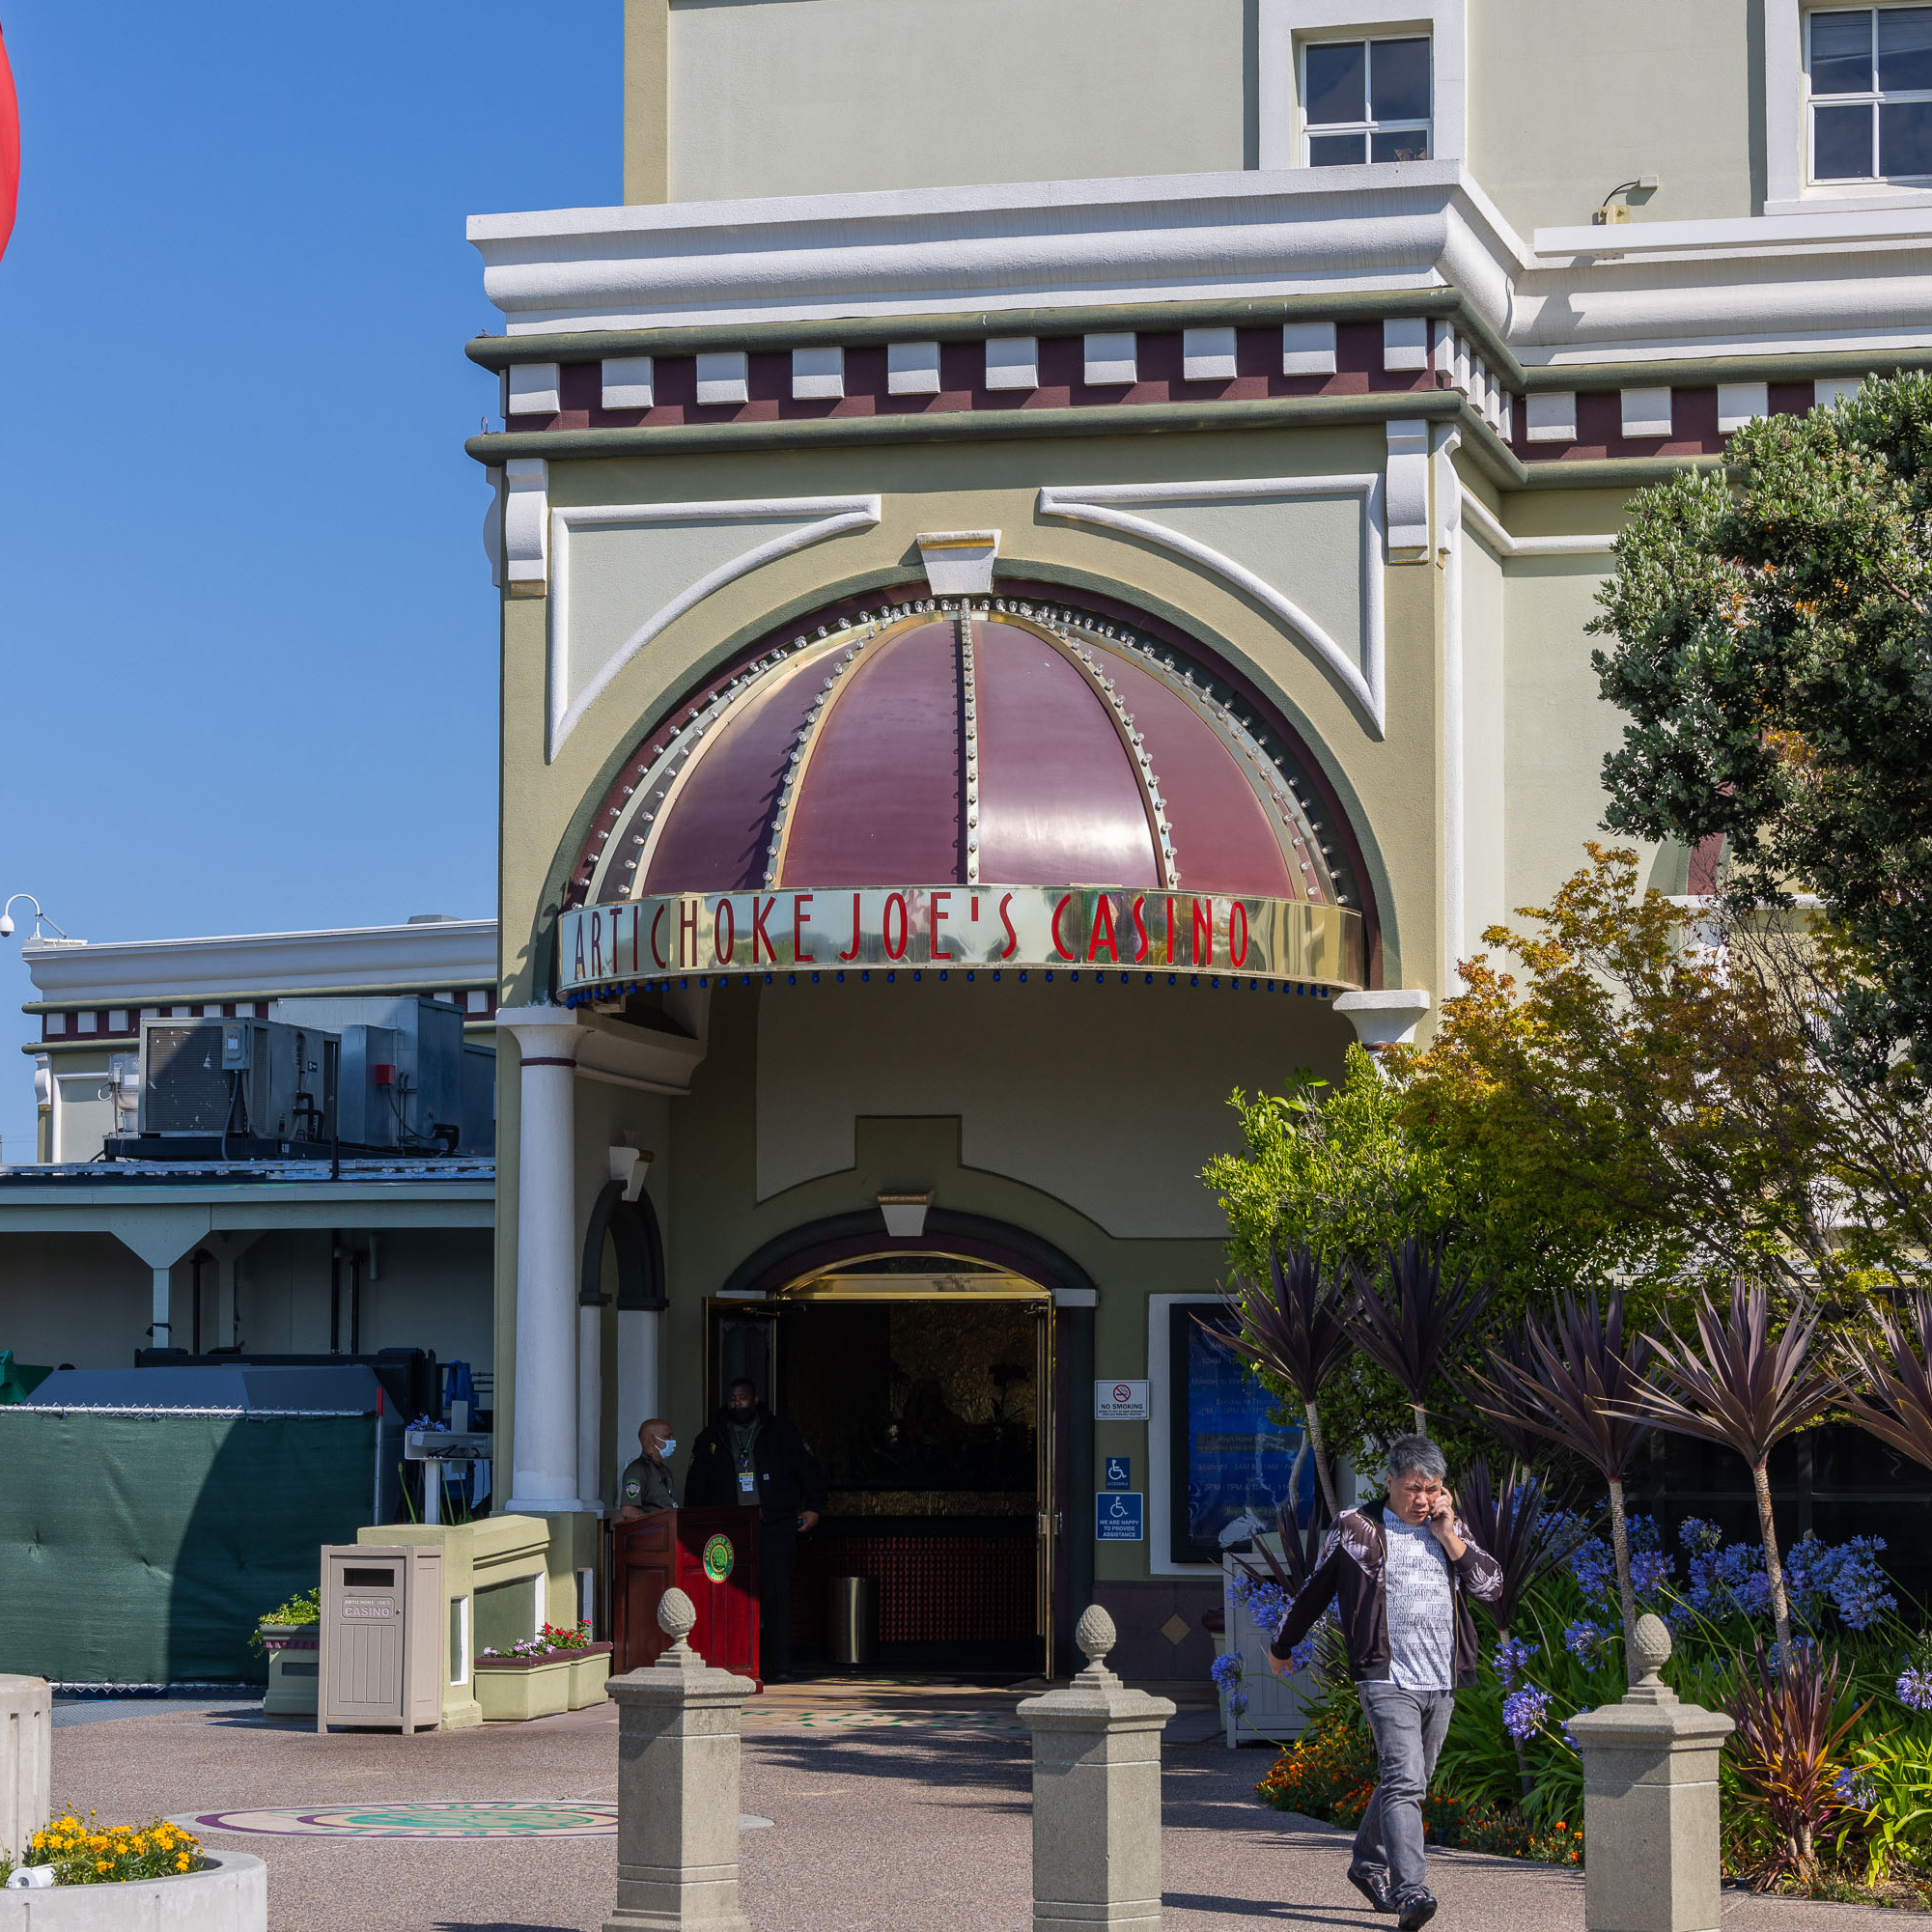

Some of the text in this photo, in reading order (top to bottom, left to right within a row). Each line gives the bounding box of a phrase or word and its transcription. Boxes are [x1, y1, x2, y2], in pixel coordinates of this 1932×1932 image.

[574, 892, 1247, 980] ARTICHOKE JOE'S CASINO
[345, 1607, 391, 1616] CASINO
